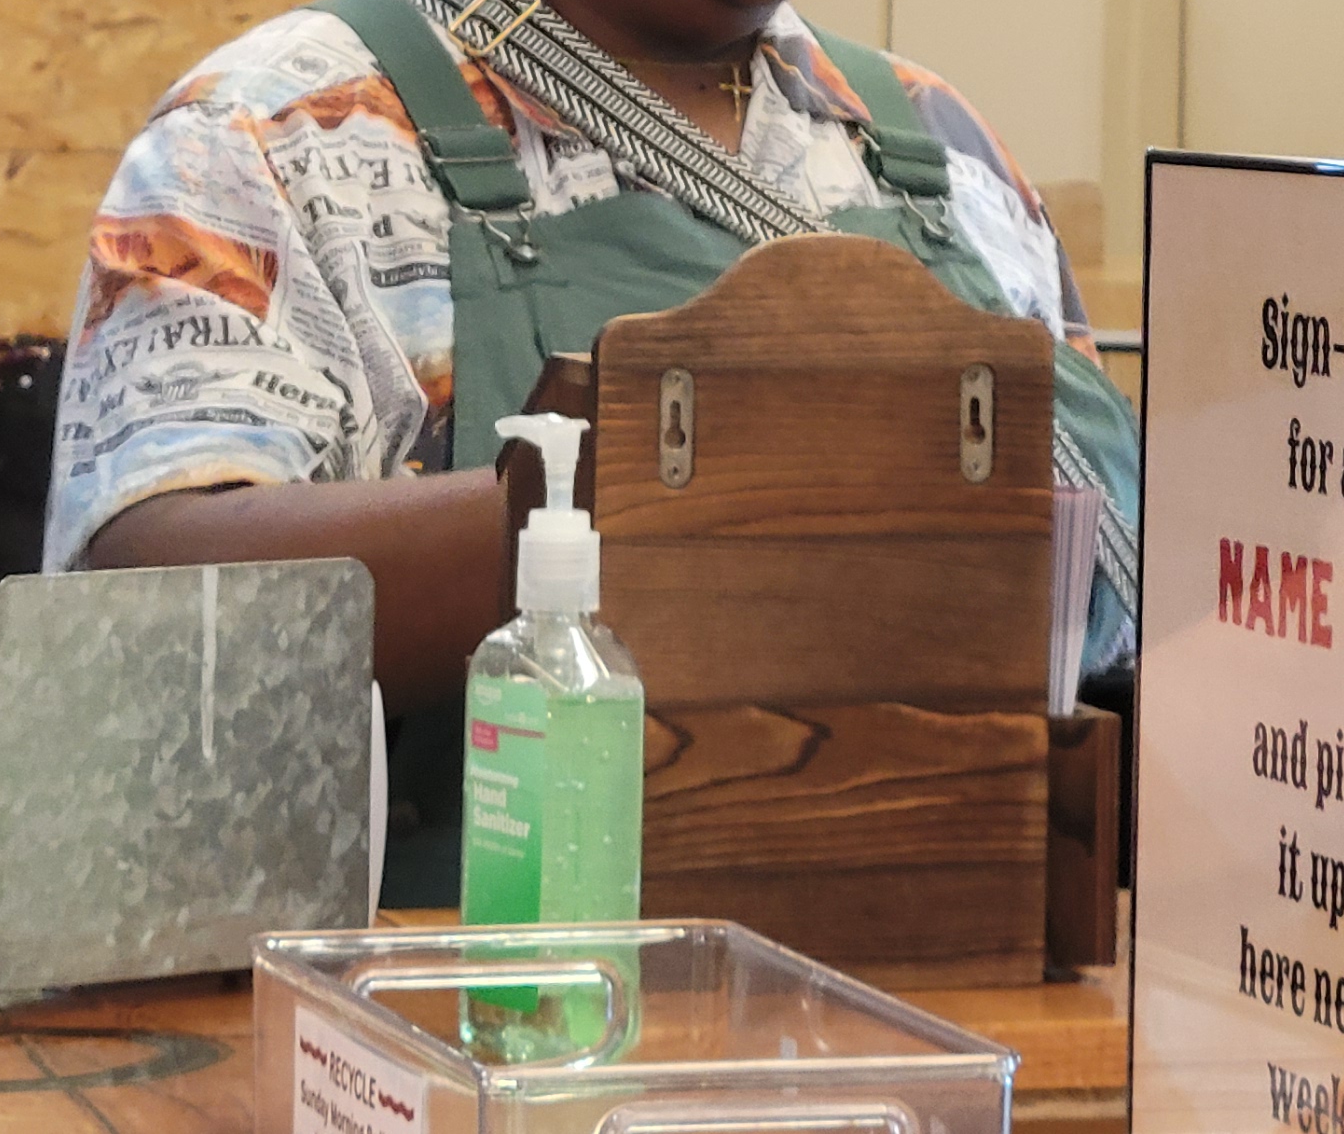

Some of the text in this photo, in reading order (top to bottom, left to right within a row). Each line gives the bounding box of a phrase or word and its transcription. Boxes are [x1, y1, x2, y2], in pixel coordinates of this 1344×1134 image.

[1287, 416, 1334, 496] for
[1218, 536, 1334, 650] NAME
[1252, 718, 1309, 791] and
[473, 780, 507, 807] Hand
[473, 804, 531, 839] Sanitizer
[1277, 825, 1304, 904] it
[1238, 922, 1306, 1018] here
[299, 1078, 330, 1128] Sunday
[328, 1050, 377, 1110] RECYCLE
